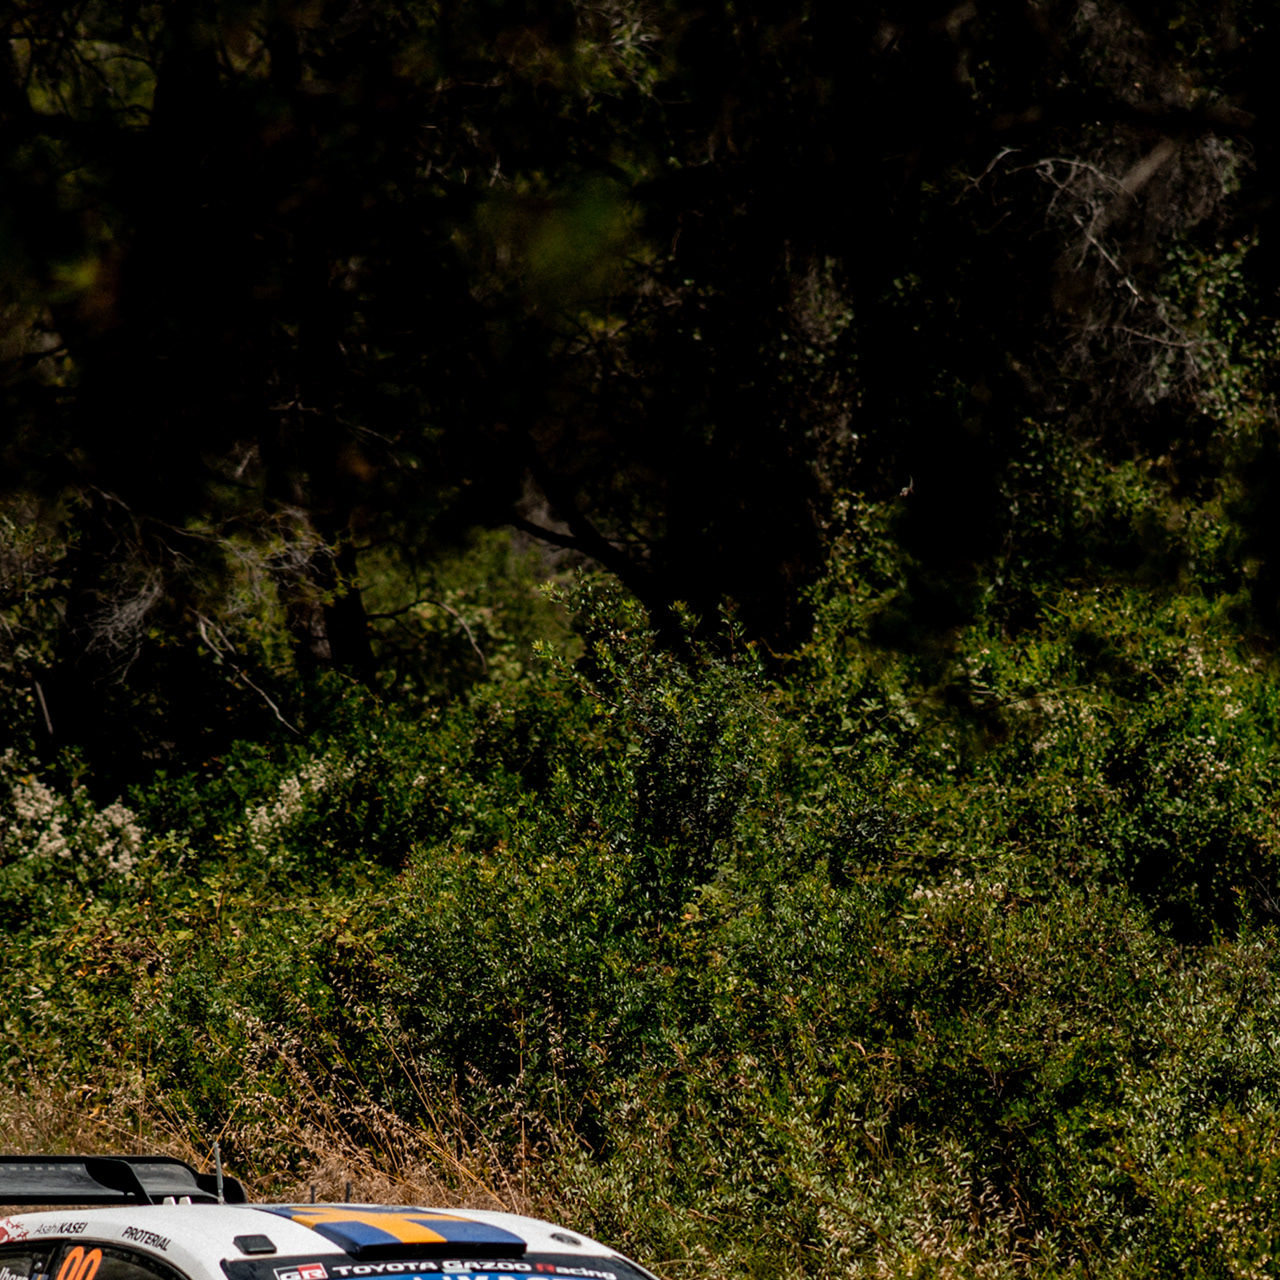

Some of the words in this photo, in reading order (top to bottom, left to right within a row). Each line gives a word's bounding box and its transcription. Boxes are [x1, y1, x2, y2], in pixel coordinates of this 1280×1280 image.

[121, 1225, 171, 1251] PROTERIAL
[332, 1262, 438, 1276] TOYOTA
[441, 1260, 532, 1271] GAZOO
[535, 1263, 617, 1280] Racing
